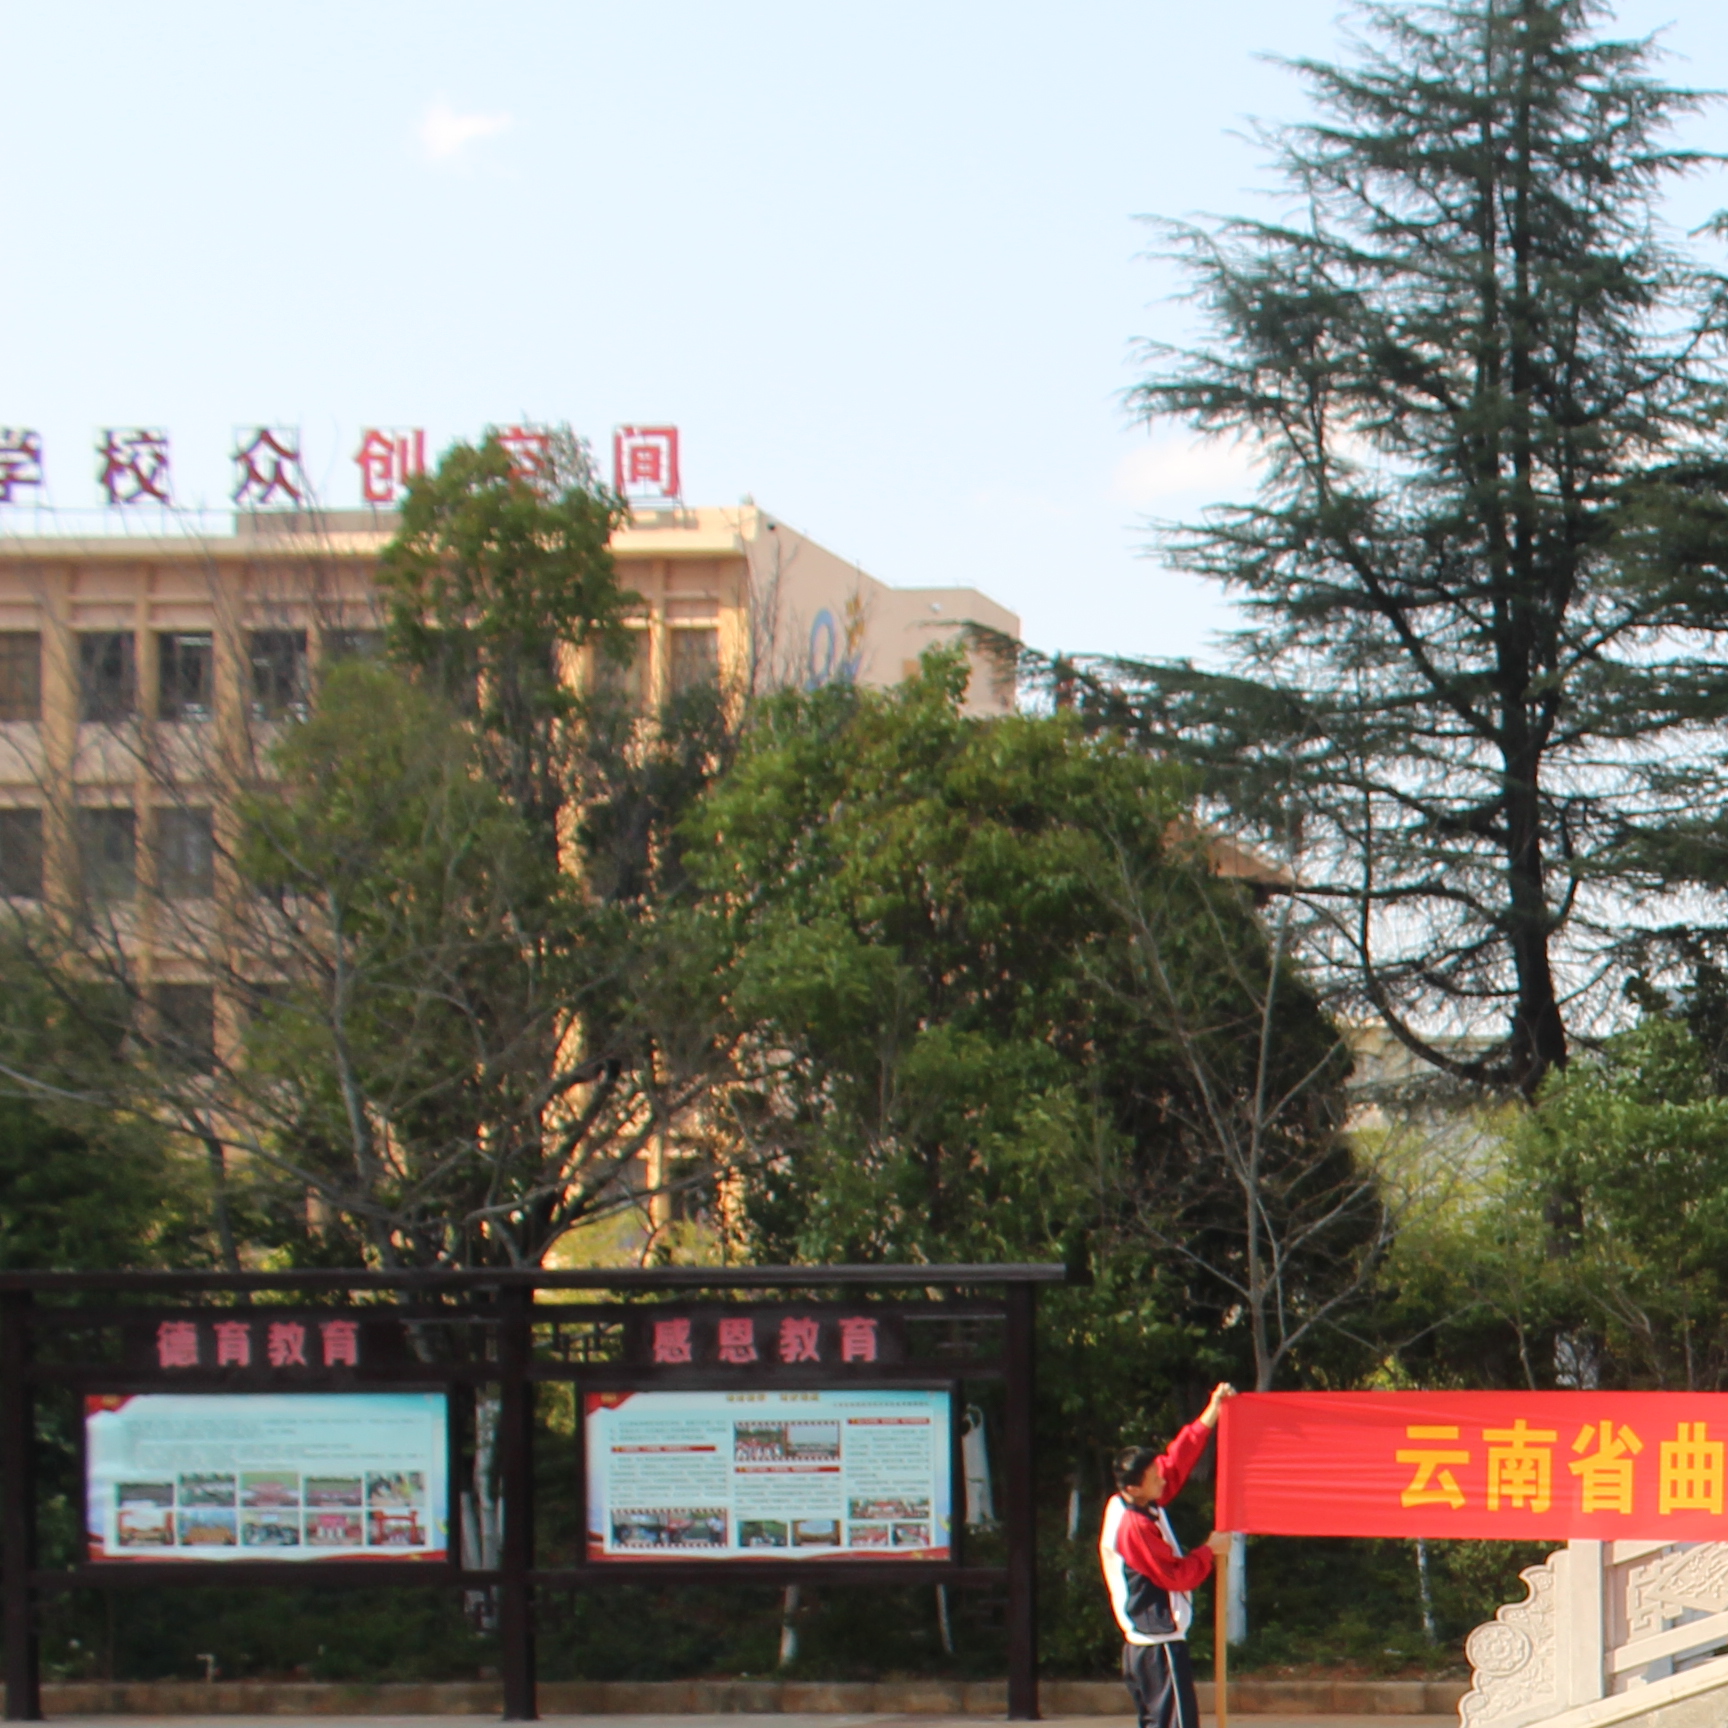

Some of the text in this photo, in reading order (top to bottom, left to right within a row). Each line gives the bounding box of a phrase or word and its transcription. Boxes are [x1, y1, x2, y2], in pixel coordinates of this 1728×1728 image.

[156, 1319, 359, 1368] 德育教育
[652, 1316, 879, 1364] 感恩教育
